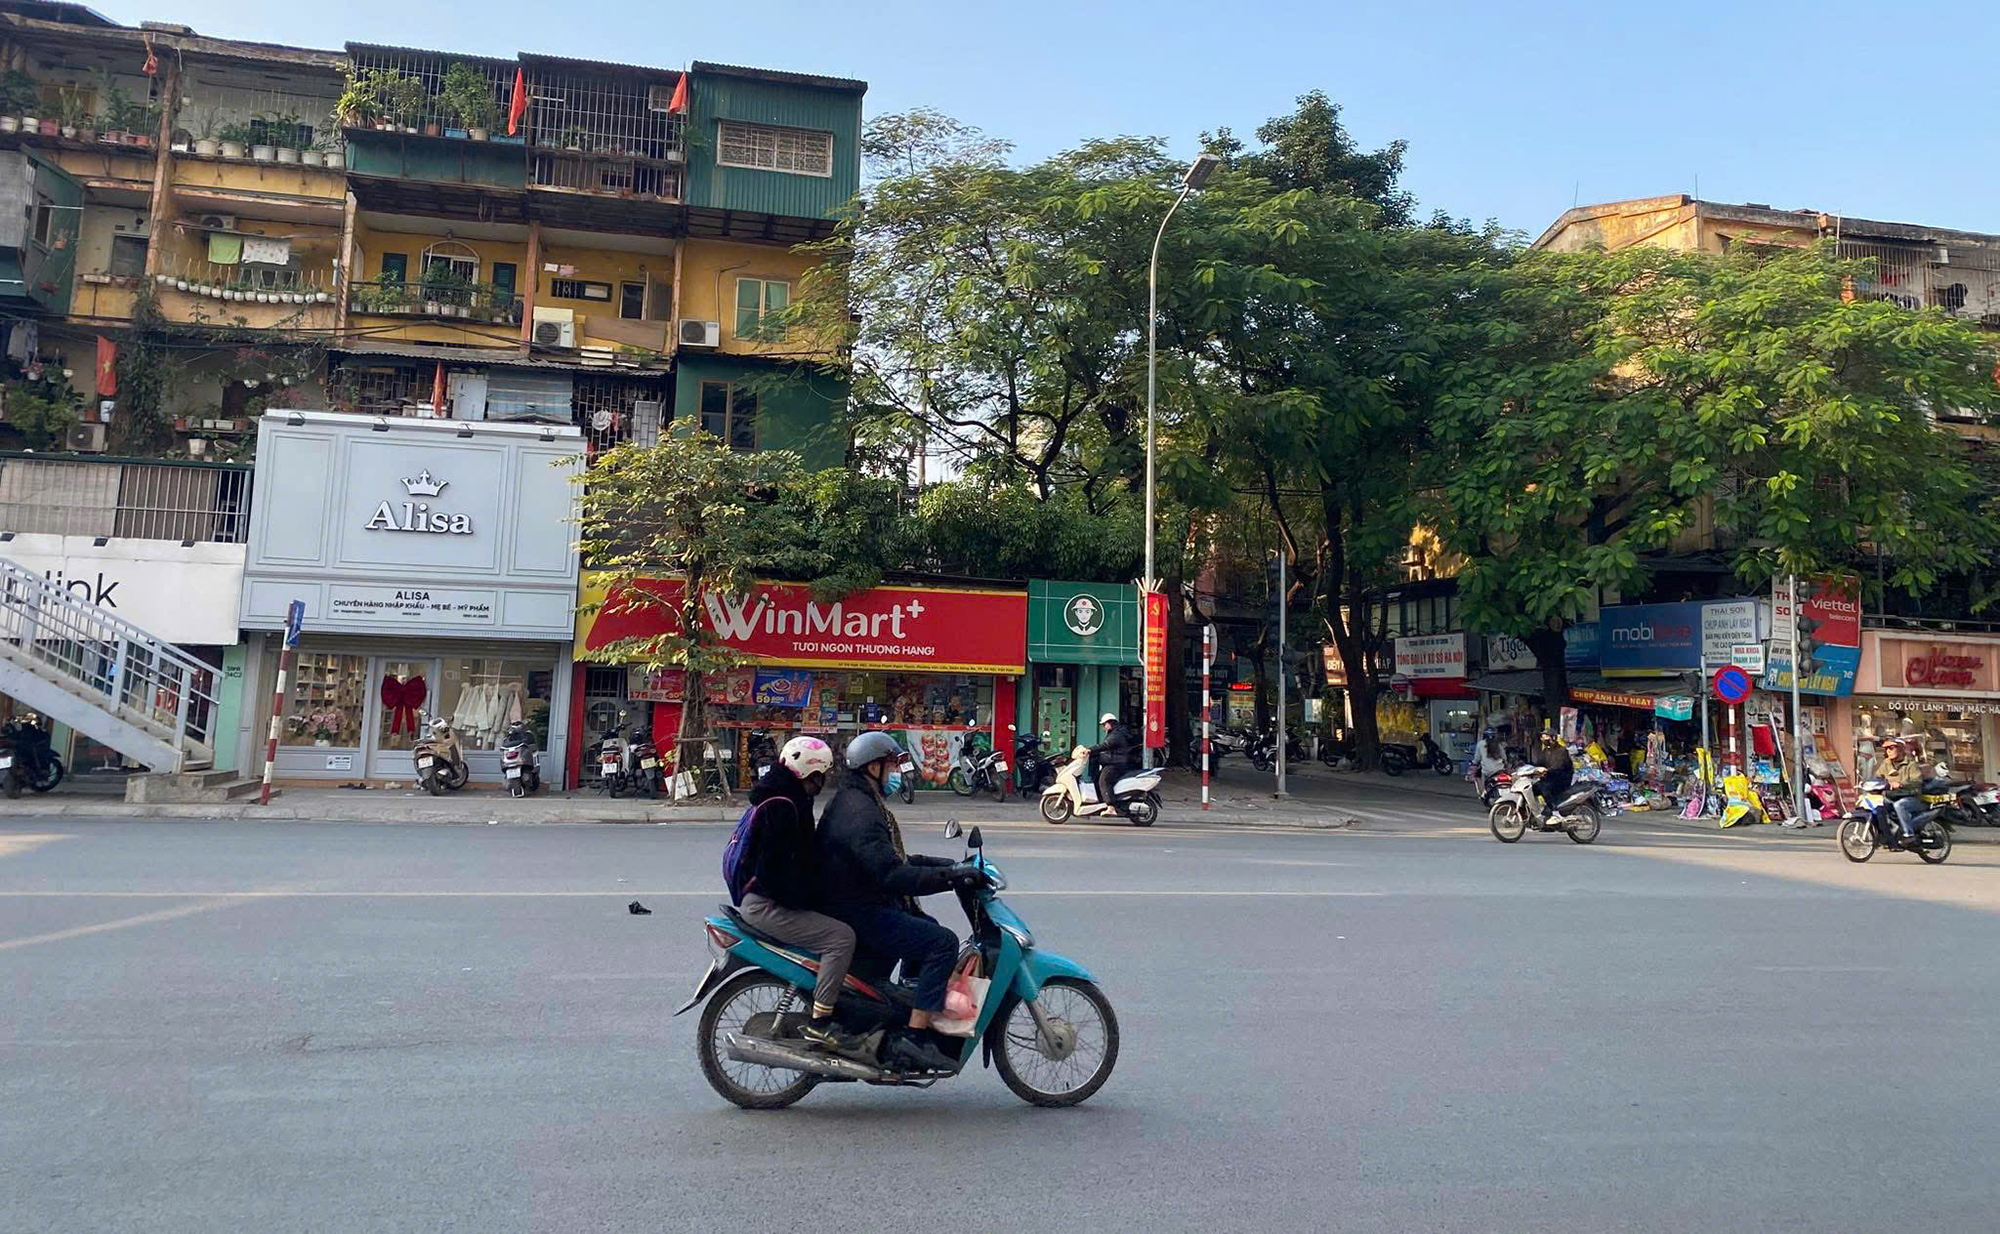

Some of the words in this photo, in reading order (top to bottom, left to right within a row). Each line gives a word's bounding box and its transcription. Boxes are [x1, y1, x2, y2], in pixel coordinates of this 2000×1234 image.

[364, 501, 473, 536] Alisa
[395, 591, 430, 601] ALISA
[821, 643, 853, 654] NGON
